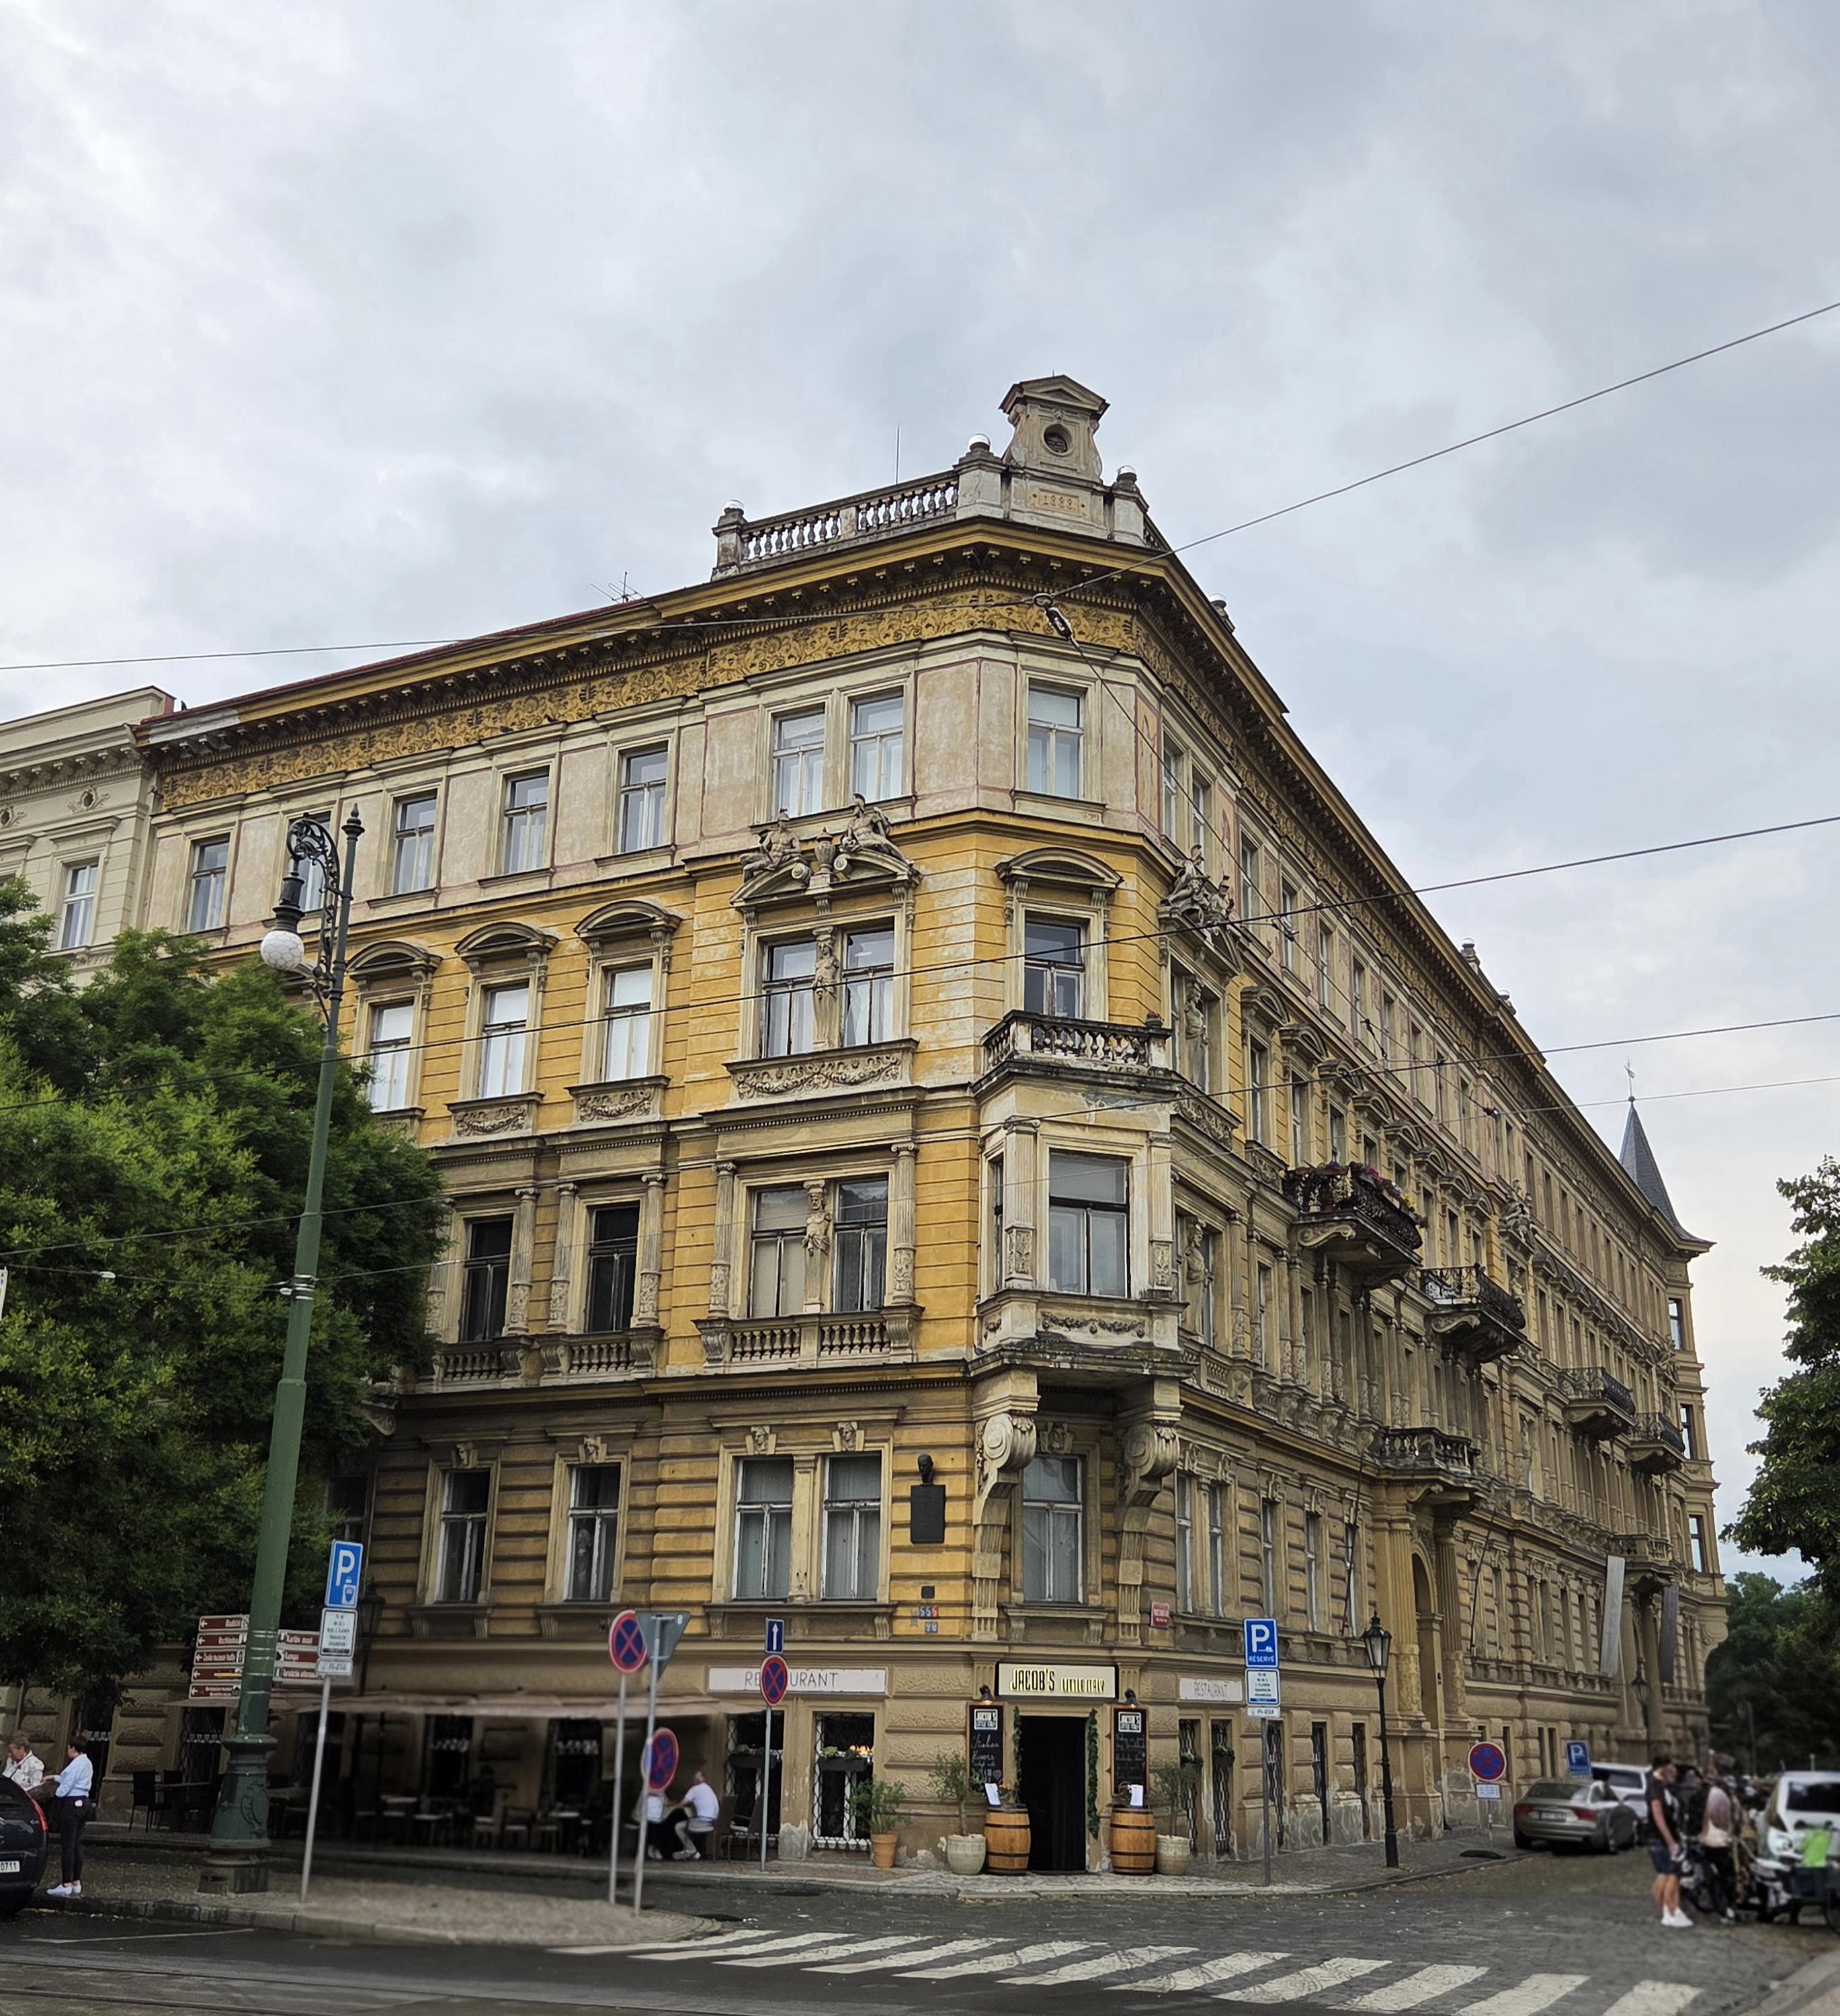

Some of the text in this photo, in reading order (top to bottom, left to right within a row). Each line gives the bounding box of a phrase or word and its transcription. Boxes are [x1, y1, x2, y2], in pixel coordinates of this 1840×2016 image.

[335, 1549, 356, 1587] P
[1251, 1624, 1270, 1653] P
[745, 1671, 839, 1687] REURANT
[1011, 1667, 1055, 1691] JACOB'S
